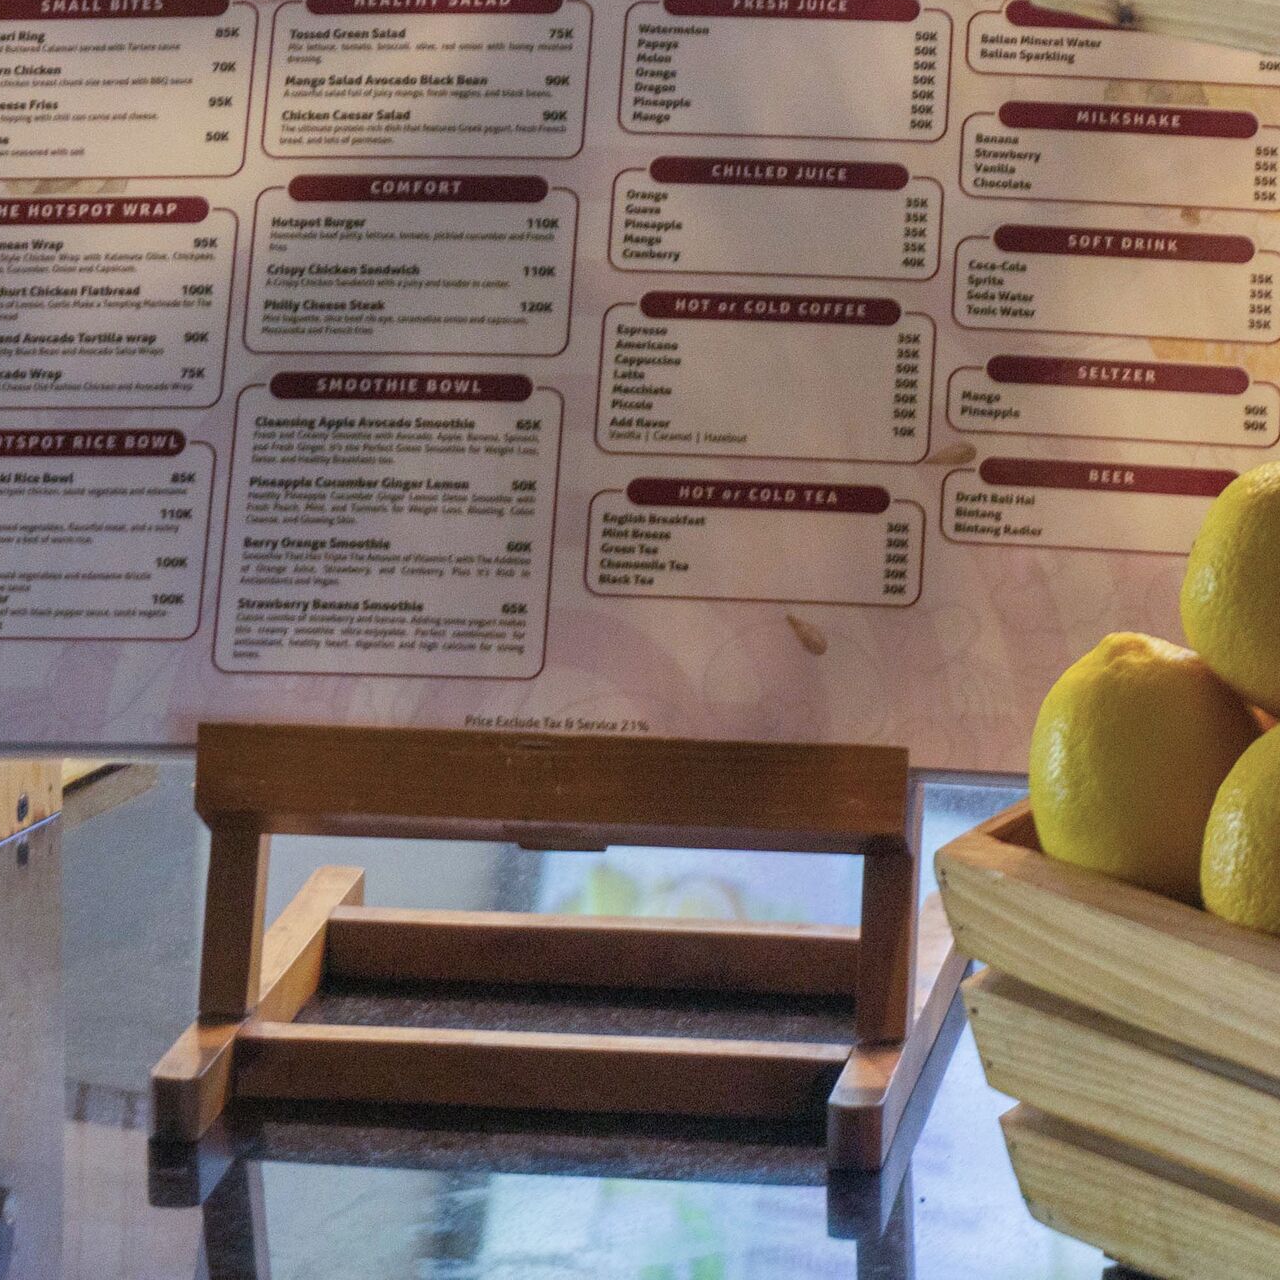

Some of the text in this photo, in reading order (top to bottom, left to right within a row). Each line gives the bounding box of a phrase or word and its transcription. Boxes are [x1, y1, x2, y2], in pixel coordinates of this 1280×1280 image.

[41, 0, 101, 13] SMALL
[19, 30, 45, 44] Ring
[215, 28, 239, 38] 85K
[290, 28, 573, 39] Tossed Green Salad 75K
[639, 24, 938, 41] Watermelon 50K
[638, 39, 678, 51] Papaya
[1020, 35, 1063, 47] Mineral
[1066, 37, 1101, 48] Water
[636, 53, 671, 63] Melon
[1020, 50, 1075, 64] Sparkling
[1259, 61, 1280, 71] 50K
[14, 64, 61, 75] Chicken
[212, 62, 236, 72] 70K
[635, 68, 676, 79] Orange
[285, 75, 570, 88] Mango Salad Avocado Black Bean 90K
[634, 82, 675, 94] Dragon
[29, 99, 58, 109] Fries
[209, 97, 232, 107] 95K
[633, 97, 691, 109] Pineapple
[282, 110, 567, 121] Chicken Caesar Salad 90K
[632, 112, 932, 129] Mango 50K
[1077, 111, 1181, 127] MILKSHAKE
[206, 132, 229, 142] 50K
[976, 134, 1278, 157] Banana 55K
[975, 148, 1041, 162] Strawberry
[711, 164, 847, 181] CHILLED JUICE
[974, 163, 1015, 174] Vanilla
[370, 181, 462, 194] COMFORT
[973, 178, 1276, 202] Chocolate 55K
[28, 204, 113, 218] HOTSPOT
[123, 203, 177, 216] WRAP
[625, 204, 927, 222] Guava 35K
[272, 217, 559, 230] Hotspot Burger 110K
[624, 219, 682, 231] Pineapple
[32, 239, 63, 252] Wrap
[194, 238, 217, 248] 95K
[1068, 235, 1178, 252] SOFT DRINK
[622, 249, 924, 267] Cranberry 40K
[969, 260, 1273, 285] Coca-Cola 35K
[968, 275, 1004, 287] Sprite
[30, 286, 77, 296] Chicken
[182, 285, 212, 295] 100K
[967, 290, 1034, 302] Soda Water
[264, 300, 552, 313] Philly Cheese Steak 120K
[675, 299, 866, 317] HOT or COLD COFFEE
[966, 305, 1035, 318] Tonic Water
[615, 340, 919, 359] Americano 35K
[614, 355, 681, 367] Cappuccino
[613, 369, 645, 380] Latte
[1077, 366, 1156, 382] SELTZER
[316, 378, 482, 393] SMOOTHIE BOWL
[962, 391, 1268, 416] Mango 90K
[961, 406, 1020, 419] Pineapple
[255, 418, 315, 431] Cleansing
[319, 418, 355, 431] Apple
[358, 418, 411, 429] Avocado
[415, 418, 475, 429] Smoothie
[610, 418, 915, 437] Add flavor 10K
[73, 436, 116, 449] RICE
[124, 436, 178, 449] BOWL
[14, 472, 40, 483] Rice
[43, 472, 73, 483] Bowl
[171, 473, 195, 483] 85K
[1088, 470, 1135, 484] BEER
[680, 486, 838, 503] HOT or COLD TEA
[956, 492, 988, 504] Draft
[991, 494, 1013, 504] Bali
[954, 523, 1000, 536] Bintang
[601, 544, 658, 555] Green Tea
[600, 559, 665, 571] Chamomile
[668, 560, 688, 571] Tea
